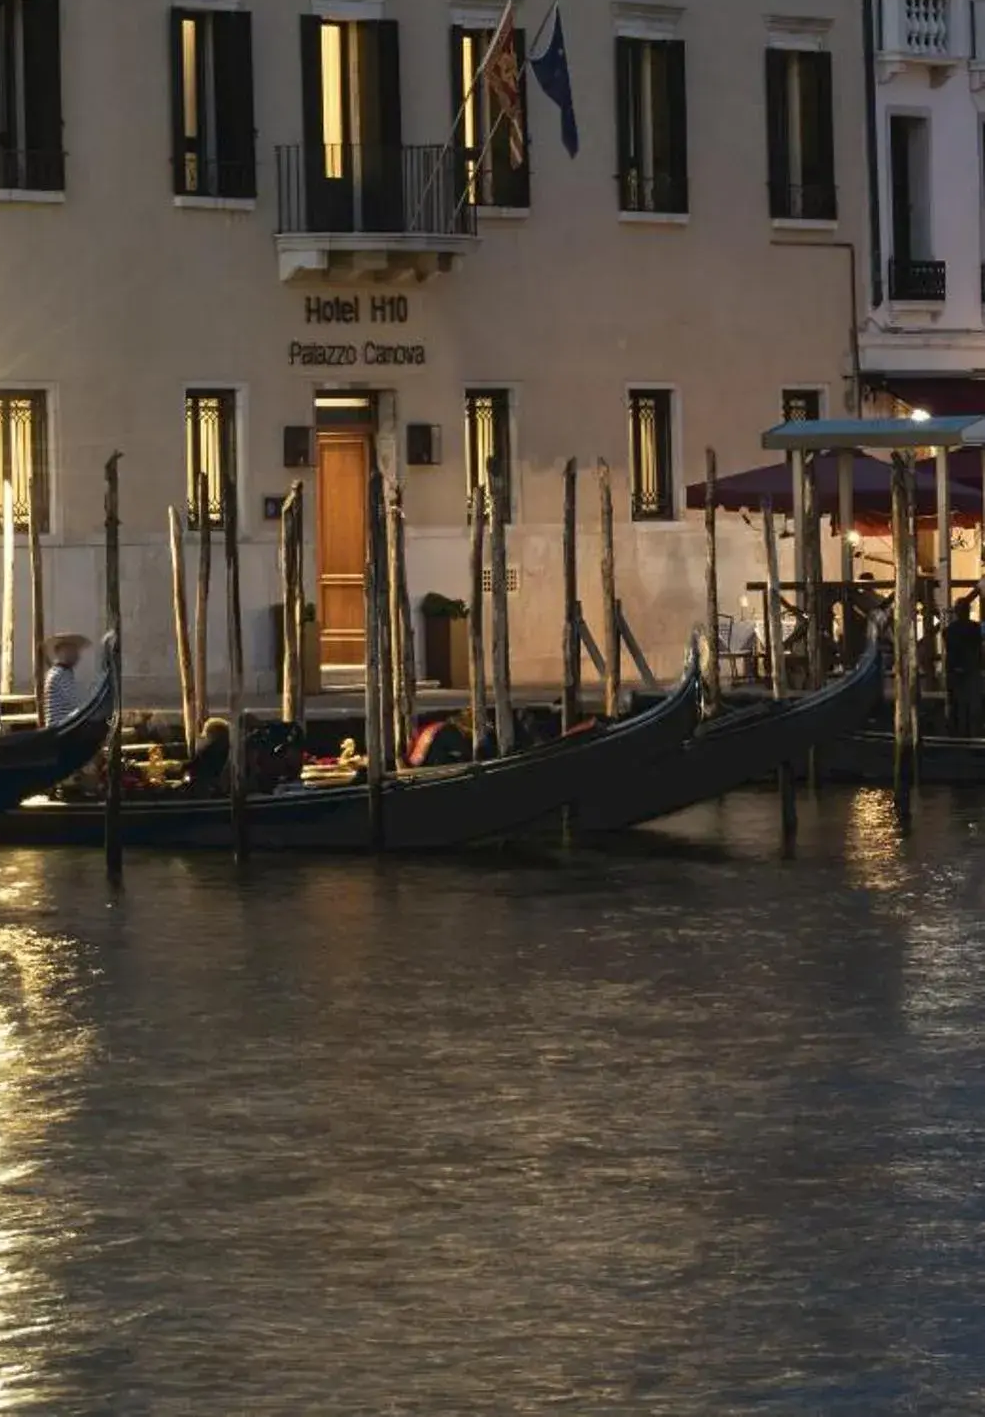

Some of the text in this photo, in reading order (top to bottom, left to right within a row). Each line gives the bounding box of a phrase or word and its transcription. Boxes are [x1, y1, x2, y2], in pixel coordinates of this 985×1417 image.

[305, 294, 408, 324] Hotel H10
[289, 340, 425, 365] Palazzo Canova
